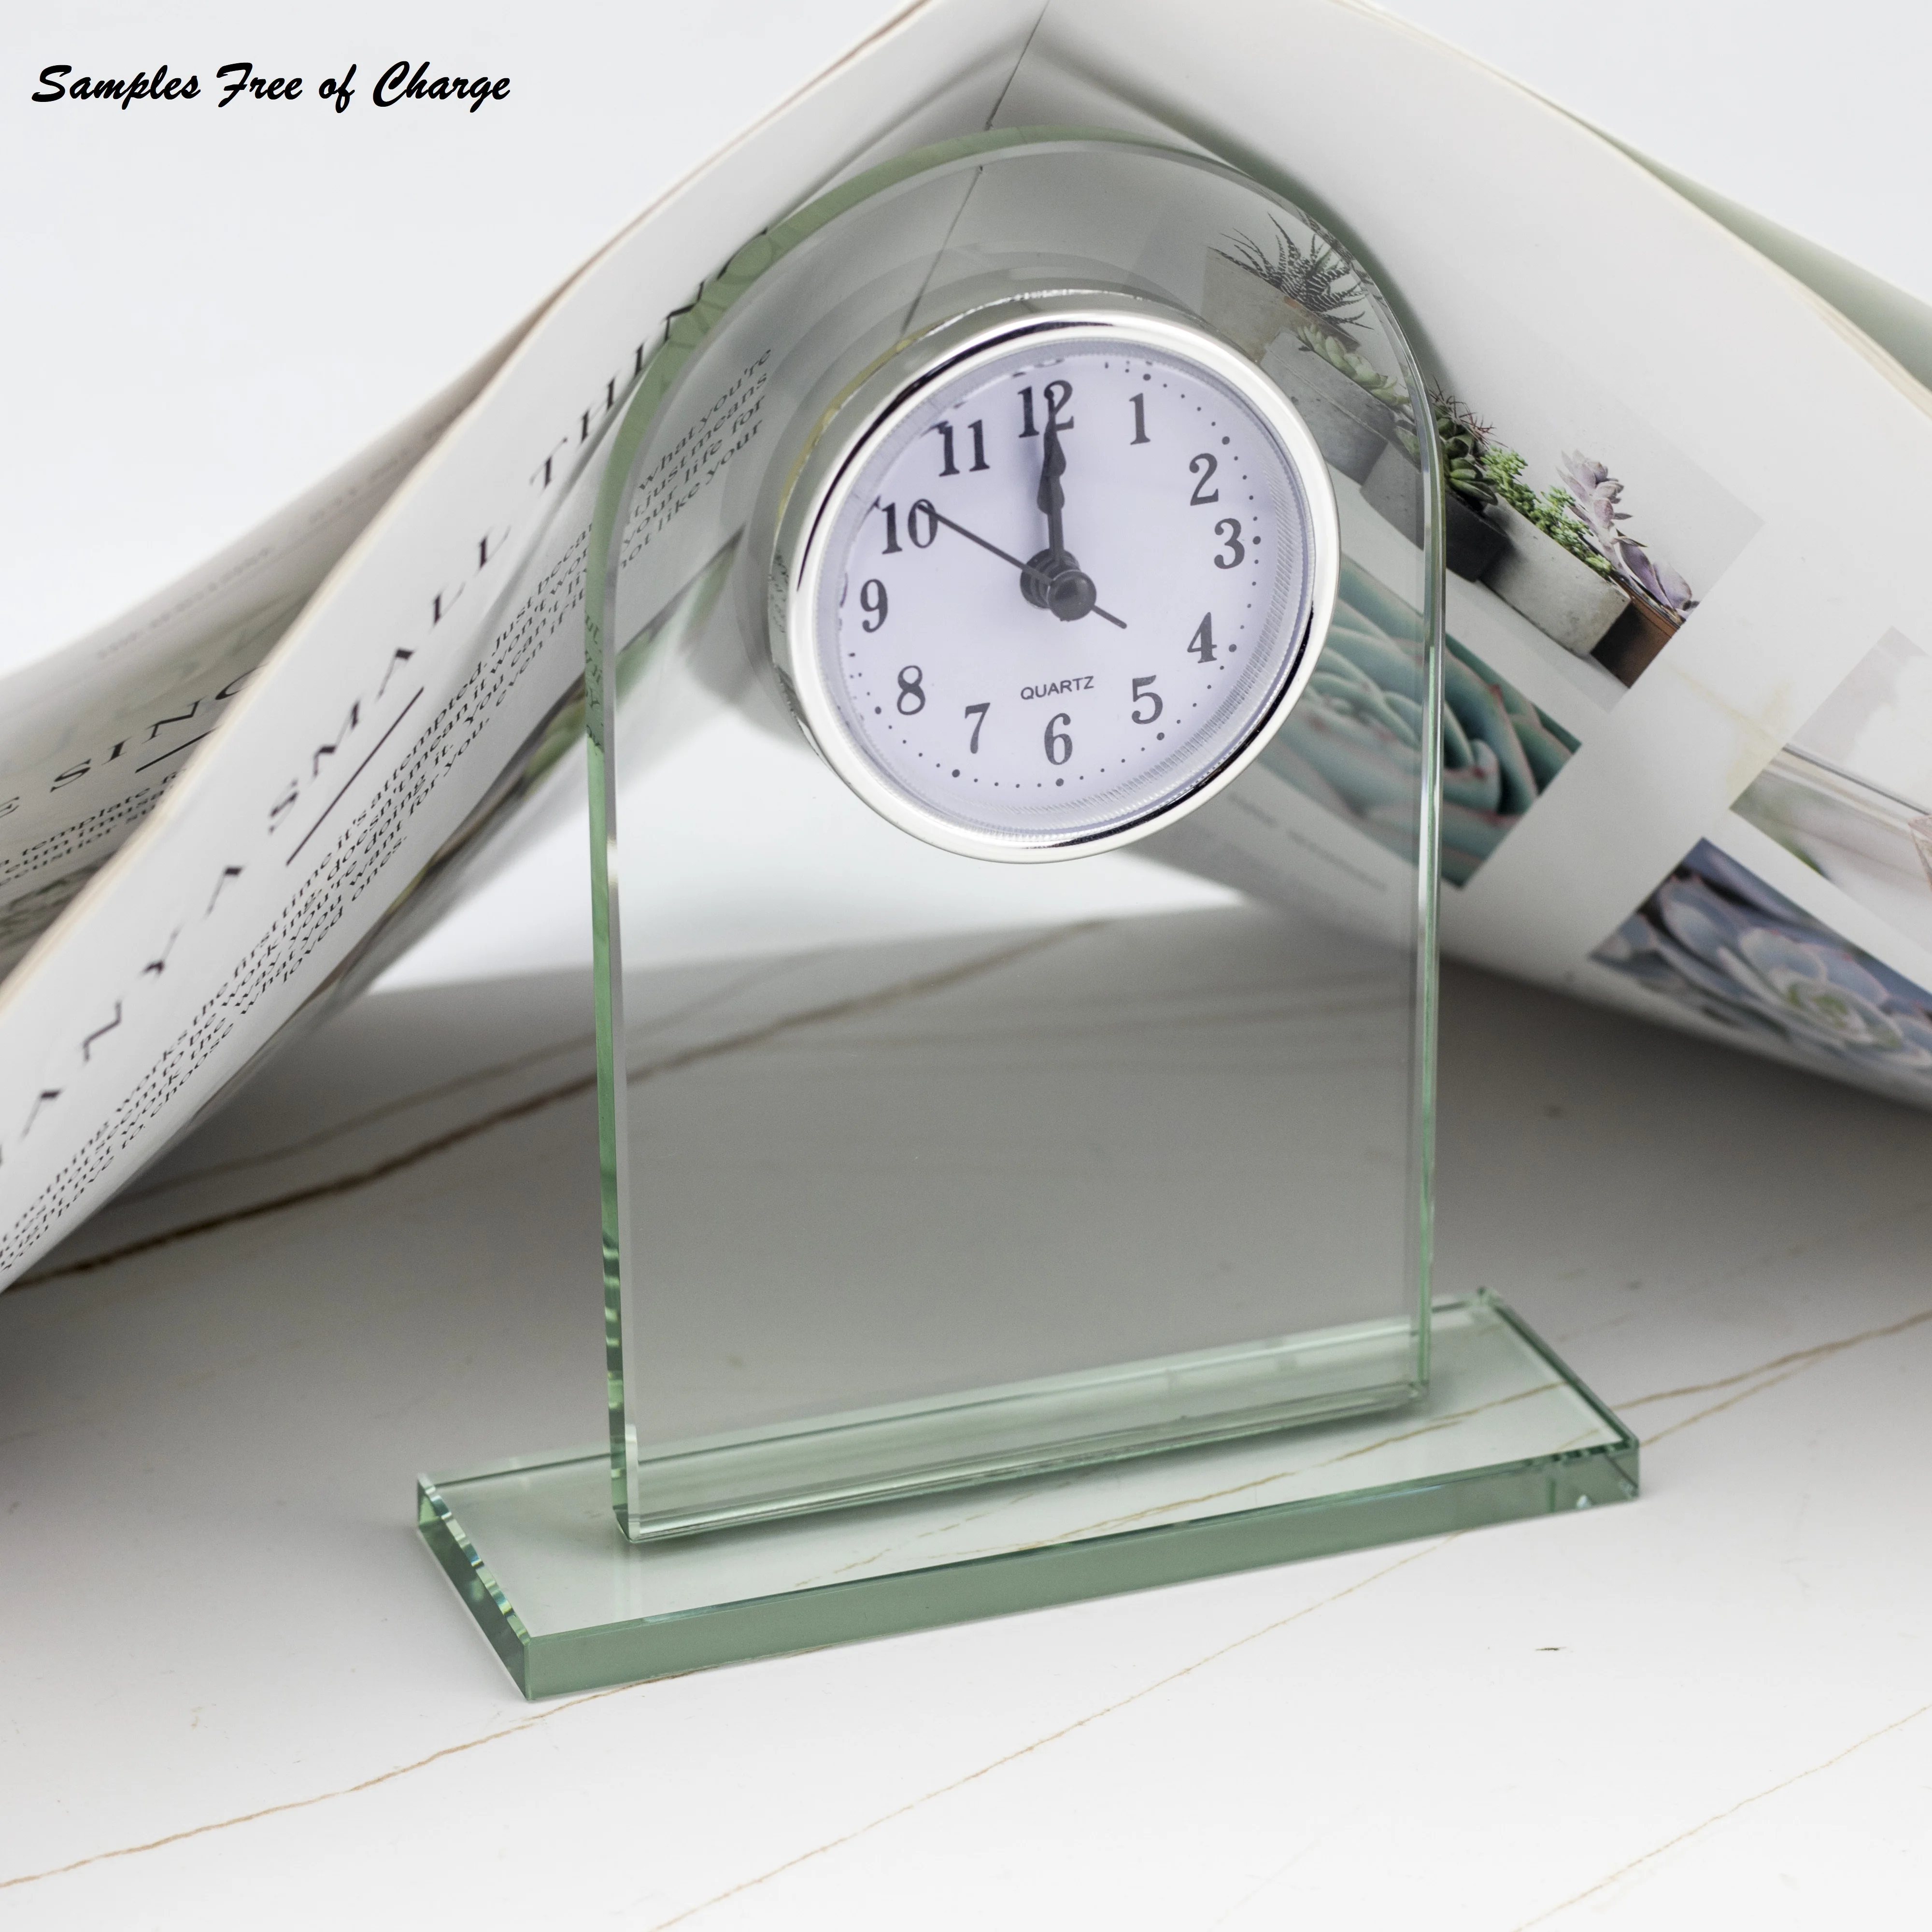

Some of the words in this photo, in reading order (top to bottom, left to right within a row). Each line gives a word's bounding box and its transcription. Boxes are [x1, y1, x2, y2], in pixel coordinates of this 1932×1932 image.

[638, 427, 697, 491] what
[698, 349, 771, 434] you're
[732, 395, 766, 436] for
[1017, 380, 1074, 438] 12
[1129, 393, 1151, 445] 1
[641, 456, 688, 520] just
[691, 373, 768, 458] means
[933, 419, 990, 477] 11
[657, 482, 700, 532] like
[705, 420, 764, 485] your
[1189, 453, 1220, 506] 2
[880, 498, 938, 555] 10
[1214, 518, 1245, 569] 3
[537, 522, 592, 596] beca
[549, 548, 588, 596] wor
[860, 579, 889, 632] 9
[1187, 612, 1217, 664] 4
[897, 665, 925, 715] 8
[1020, 675, 1094, 700] QUARTZ
[1131, 675, 1163, 724] 5
[965, 702, 991, 754] 7
[1043, 713, 1073, 766] 6
[0, 919, 185, 1168] ANY
[202, 863, 248, 922] A
[267, 524, 512, 837] SMALL
